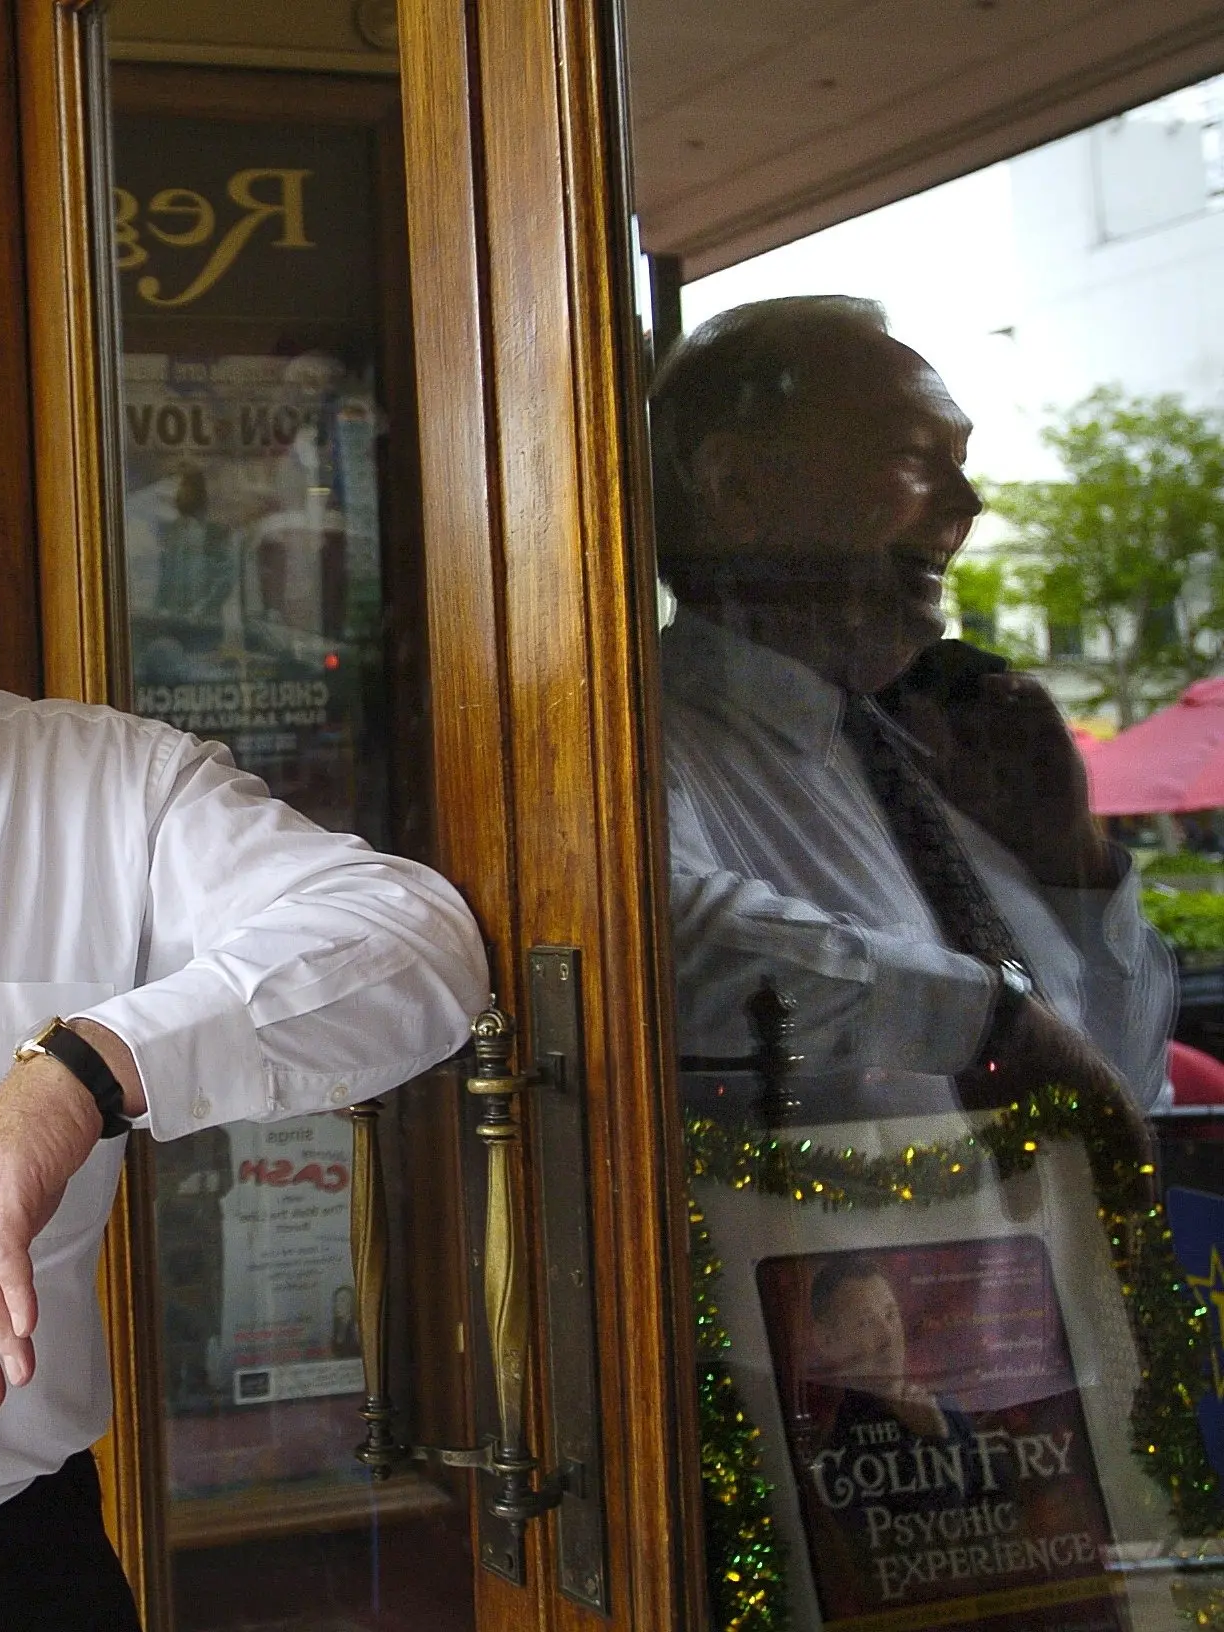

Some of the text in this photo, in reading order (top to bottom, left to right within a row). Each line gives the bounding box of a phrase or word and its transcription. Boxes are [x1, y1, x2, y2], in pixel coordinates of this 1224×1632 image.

[850, 1421, 901, 1447] THE
[972, 1425, 1075, 1493] FRY
[862, 1500, 1019, 1549] PSYCHIC
[874, 1531, 1098, 1601] EXPERIENCE
